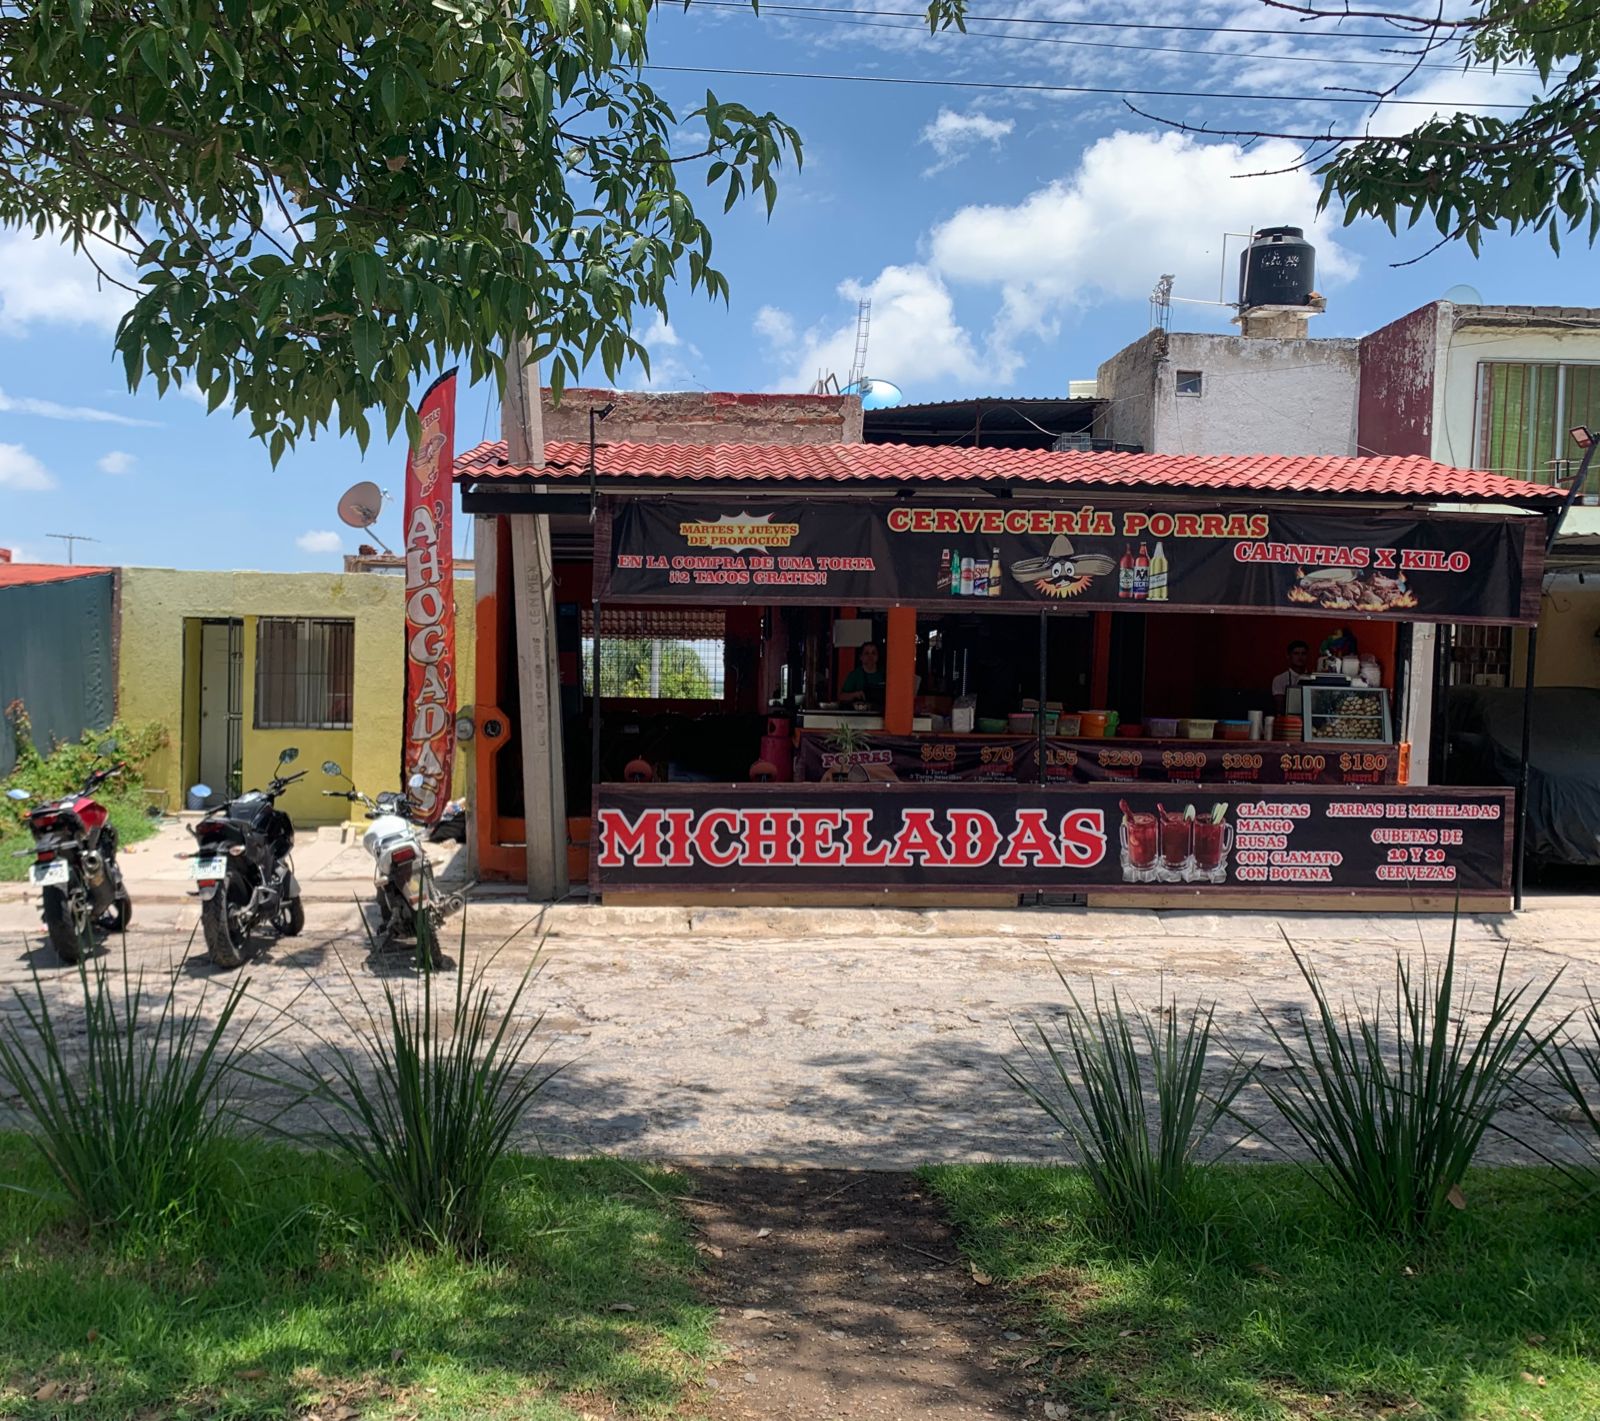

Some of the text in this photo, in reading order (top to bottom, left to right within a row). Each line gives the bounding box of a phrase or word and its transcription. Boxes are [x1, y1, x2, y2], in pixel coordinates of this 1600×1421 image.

[681, 524, 798, 535] MARTES Y JUEVES
[887, 506, 1269, 538] CERVECERÍA PORRAS
[689, 534, 789, 547] DE PROMOCIÓN
[617, 555, 875, 571] EN LA COMPRA DE UNA TORTA
[1234, 542, 1471, 573] CARNITAS X KILO
[694, 571, 749, 584] TACOS
[753, 571, 828, 585] GRATIS!!
[406, 505, 447, 817] AHOGADAS
[822, 750, 893, 768] PORRAS
[921, 743, 956, 762] $65
[980, 746, 1014, 763] $70
[1098, 749, 1143, 766] $280
[1162, 750, 1206, 768] $380
[1280, 753, 1325, 771] $100
[1340, 752, 1387, 771] $180
[1236, 801, 1311, 818] CLÁSICAS
[1326, 803, 1500, 819] JARRAS DE MICHELADAS
[1236, 819, 1294, 834] MANGO
[598, 808, 1107, 867] MICHELADAS
[1236, 835, 1288, 849] RUSAS
[1371, 828, 1463, 844] CUBETAS DE
[1236, 851, 1343, 866] CON CLAMATO
[1387, 848, 1445, 862] 10 Y 20
[1236, 866, 1332, 881] CON BOTANA
[1376, 866, 1456, 881] CERVEZAS
